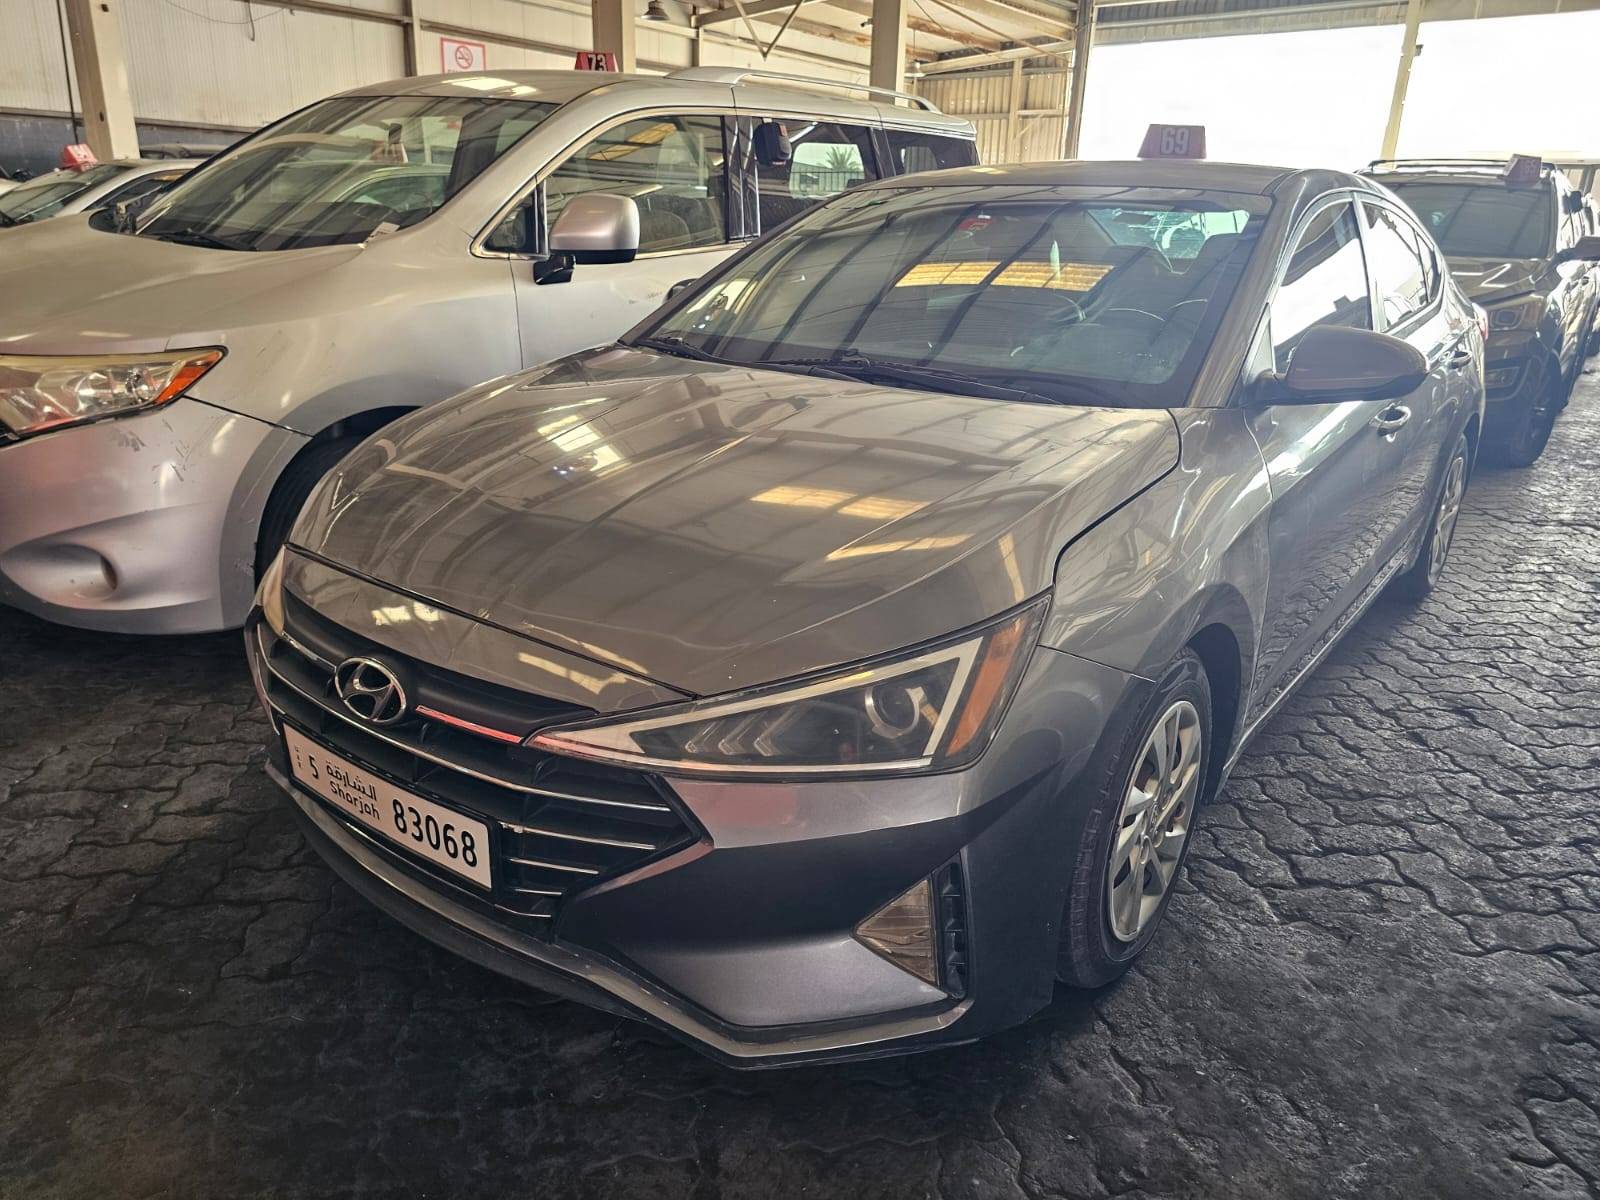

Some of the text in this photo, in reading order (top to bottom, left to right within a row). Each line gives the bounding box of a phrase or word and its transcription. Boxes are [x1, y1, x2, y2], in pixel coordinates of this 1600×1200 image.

[588, 54, 607, 71] 73
[1160, 127, 1190, 155] 69
[308, 755, 320, 780] 5
[326, 760, 377, 801] الشارقة
[330, 781, 381, 821] Sharjah
[392, 799, 478, 868] 83068
